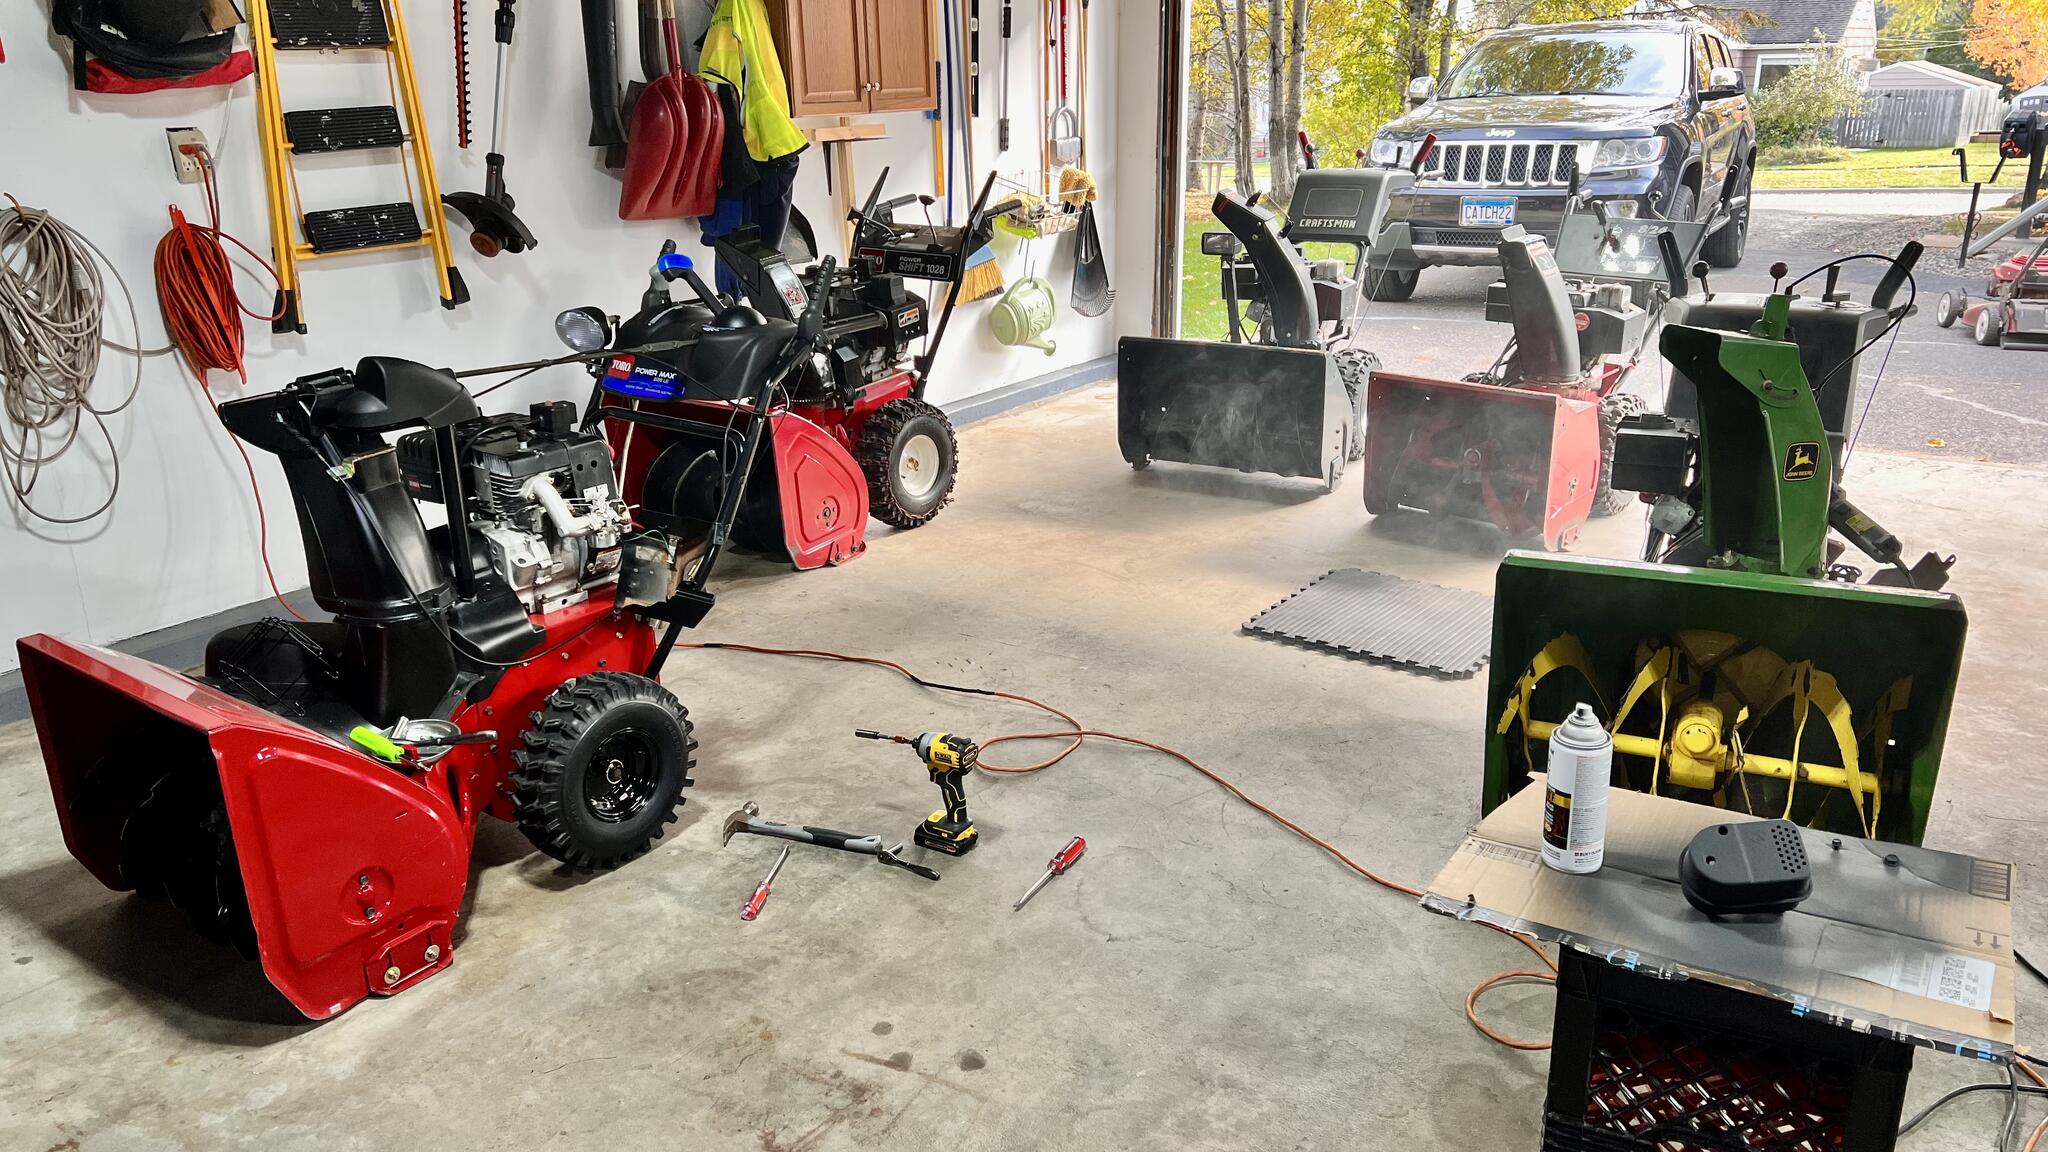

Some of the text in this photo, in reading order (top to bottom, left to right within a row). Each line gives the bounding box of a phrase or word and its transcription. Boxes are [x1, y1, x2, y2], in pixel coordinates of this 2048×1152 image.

[1486, 128, 1515, 138] Jeep
[1465, 205, 1512, 220] CATCH22
[1299, 218, 1357, 229] CRAFTSMAN
[899, 255, 922, 263] POWER
[898, 261, 945, 275] SHIFT 1028
[611, 359, 632, 372] TORO
[634, 366, 677, 380] POWER MAX
